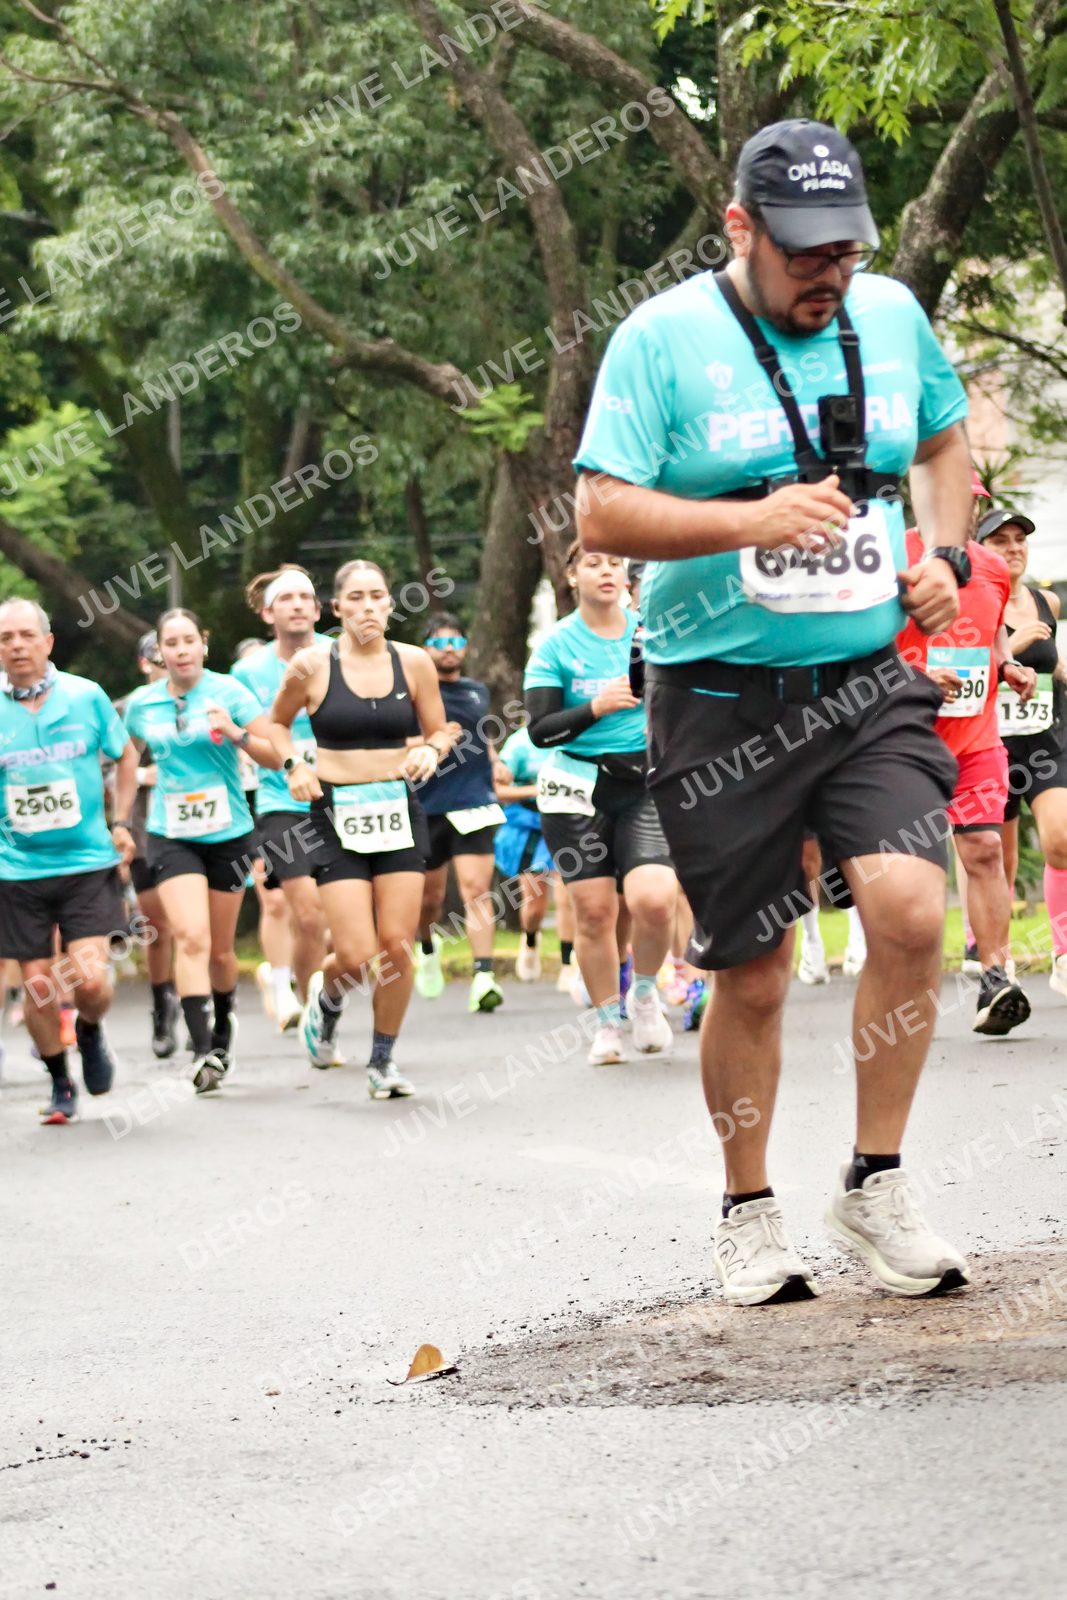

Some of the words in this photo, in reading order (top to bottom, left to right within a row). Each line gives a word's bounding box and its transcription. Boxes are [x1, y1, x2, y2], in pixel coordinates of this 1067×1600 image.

[788, 161, 817, 181] ON
[820, 160, 853, 179] ARA
[708, 392, 913, 451] PERDRA
[755, 533, 881, 578] 6486
[1001, 702, 1049, 721] 1373
[0, 739, 87, 767] ERDURA
[15, 793, 73, 816] 2906
[177, 800, 217, 821] 347
[343, 812, 403, 835] 6318
